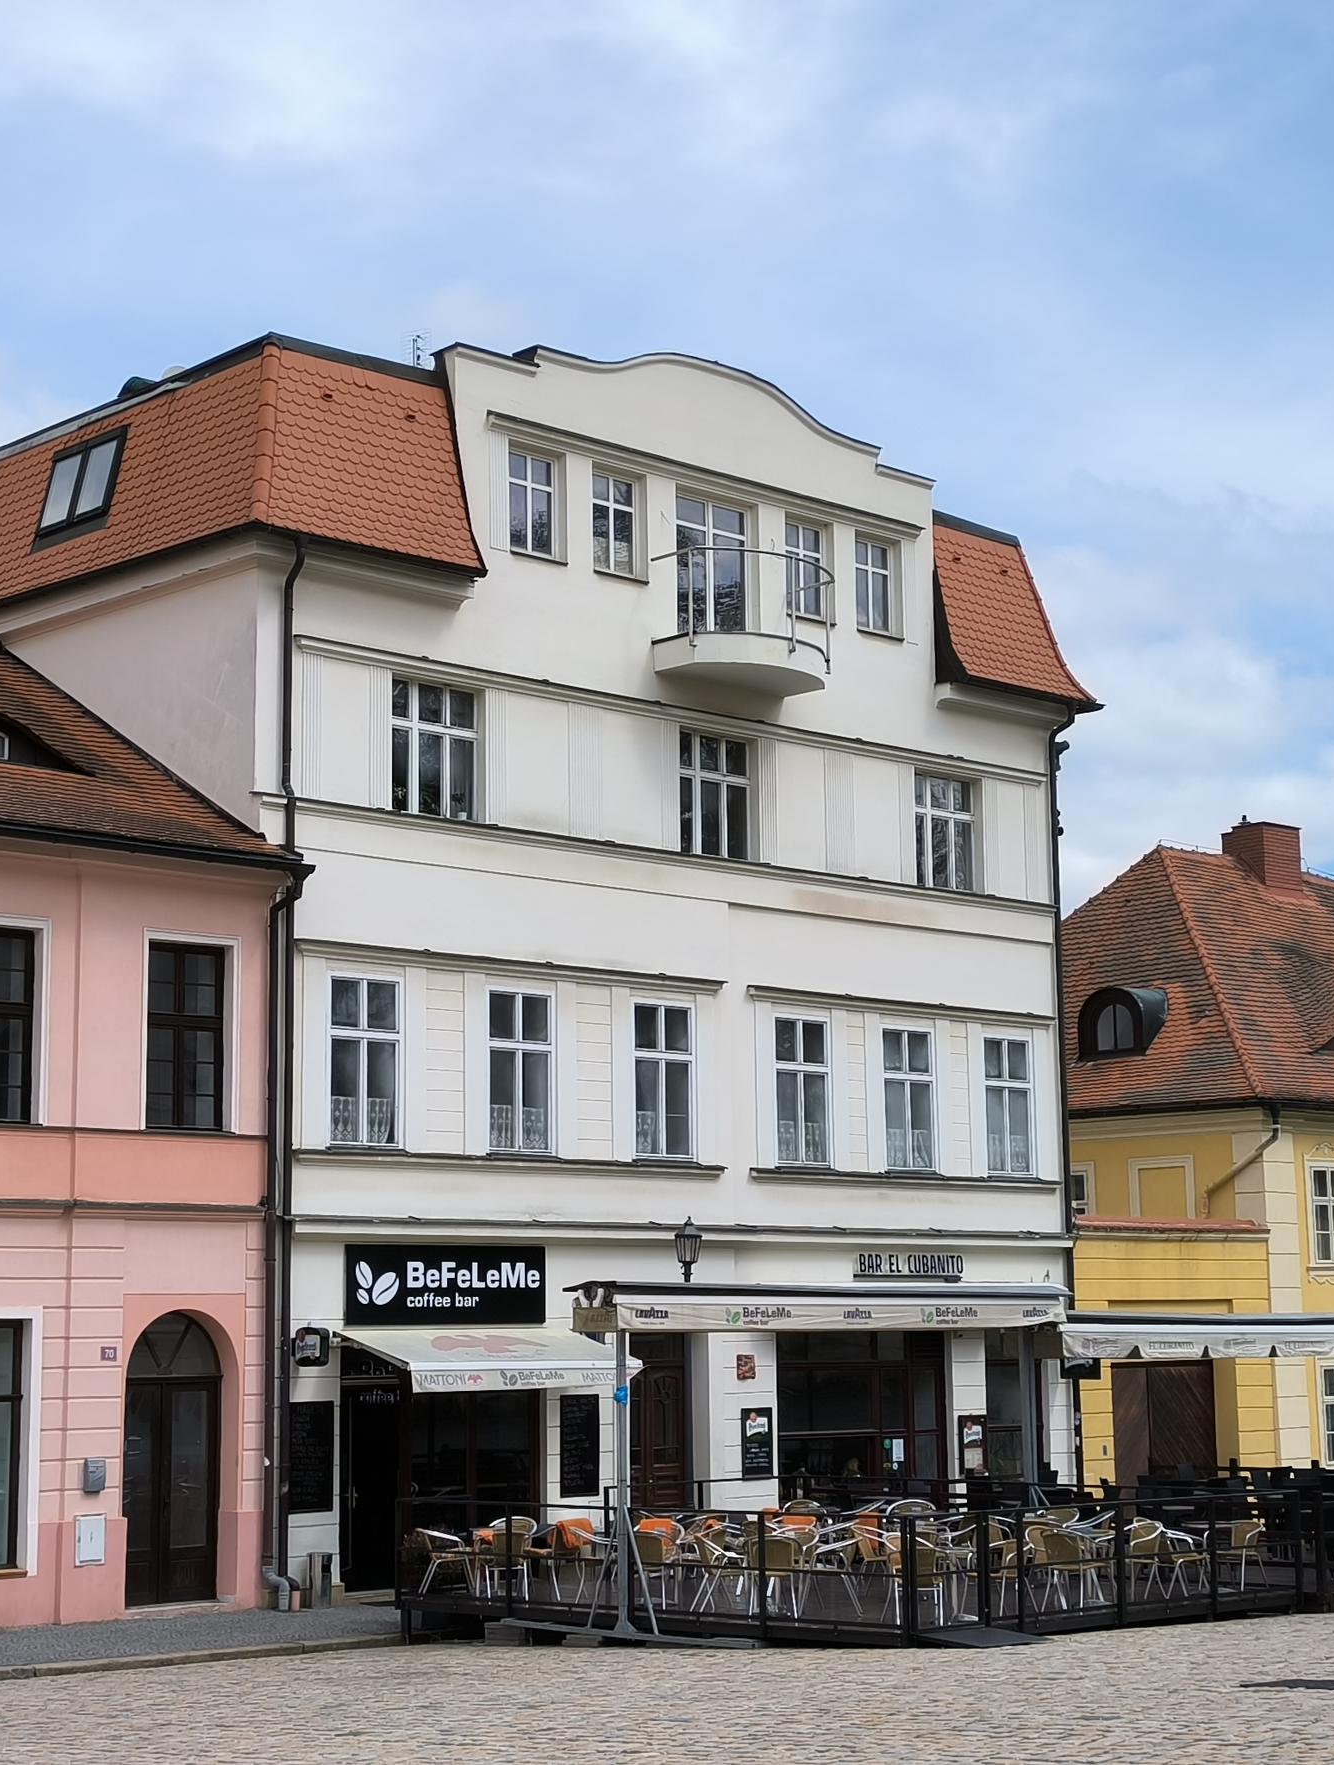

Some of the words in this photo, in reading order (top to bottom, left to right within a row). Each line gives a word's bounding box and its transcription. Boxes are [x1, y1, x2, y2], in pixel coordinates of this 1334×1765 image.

[858, 1253, 883, 1273] BAR
[888, 1254, 902, 1273] EL
[907, 1254, 964, 1274] CUBANITO
[406, 1261, 541, 1289] BeFeLeMe
[406, 1292, 452, 1308] coffee
[455, 1292, 479, 1308] bar
[742, 1306, 792, 1318] BeFeLeMe
[935, 1306, 978, 1318] BeFeLeMe
[104, 1349, 115, 1359] 70
[419, 1373, 467, 1386] MATTONI
[517, 1370, 565, 1381] BeFeLeMe
[581, 1371, 616, 1382] MATTO
